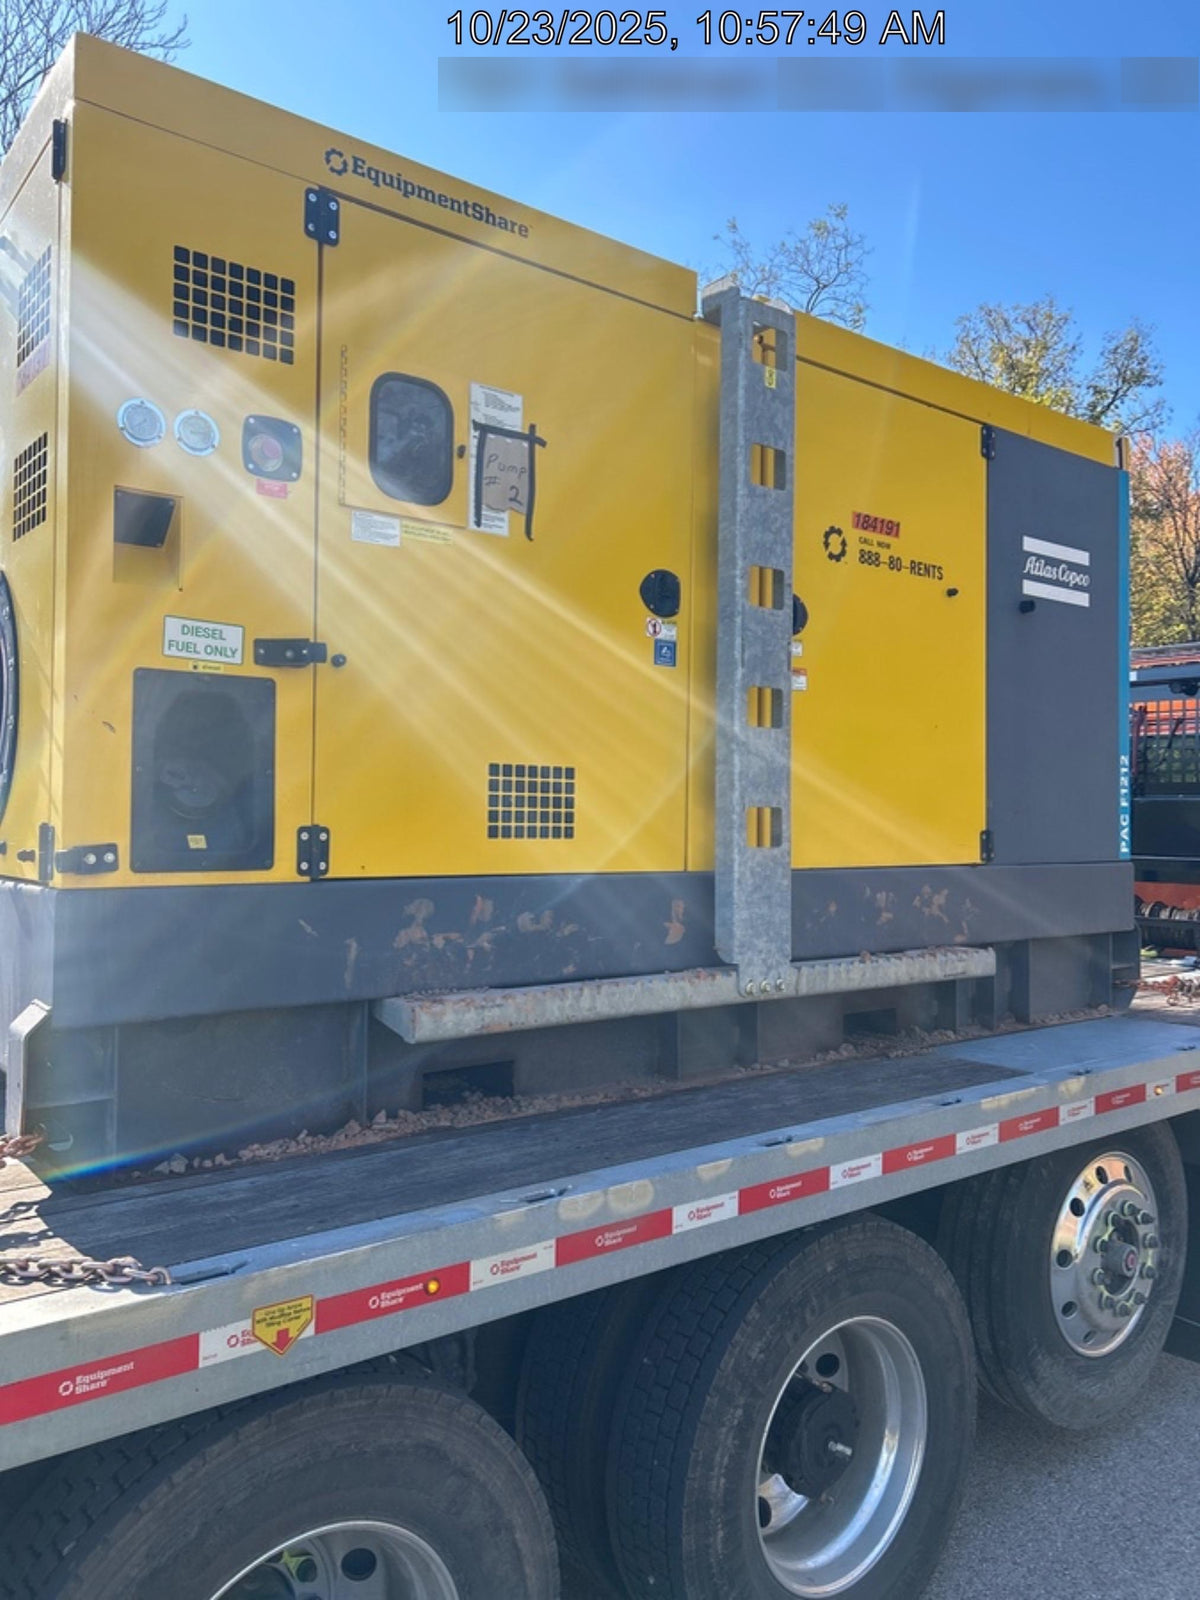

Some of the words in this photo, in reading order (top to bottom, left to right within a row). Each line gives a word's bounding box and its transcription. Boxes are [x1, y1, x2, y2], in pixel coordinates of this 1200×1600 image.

[352, 155, 530, 239] EquipmentShare
[485, 453, 528, 480] Pump
[507, 485, 523, 506] 2
[854, 512, 901, 538] 184191
[858, 548, 944, 581] 888-80-RENTS
[1022, 556, 1057, 580] Atlas
[1058, 563, 1091, 587] Copco
[180, 624, 227, 641] DIESEL
[167, 639, 201, 655] FUEL
[203, 644, 239, 658] ONLY
[1119, 813, 1130, 853] PAC
[75, 1361, 135, 1385] Equipment
[75, 1379, 108, 1394] Share
